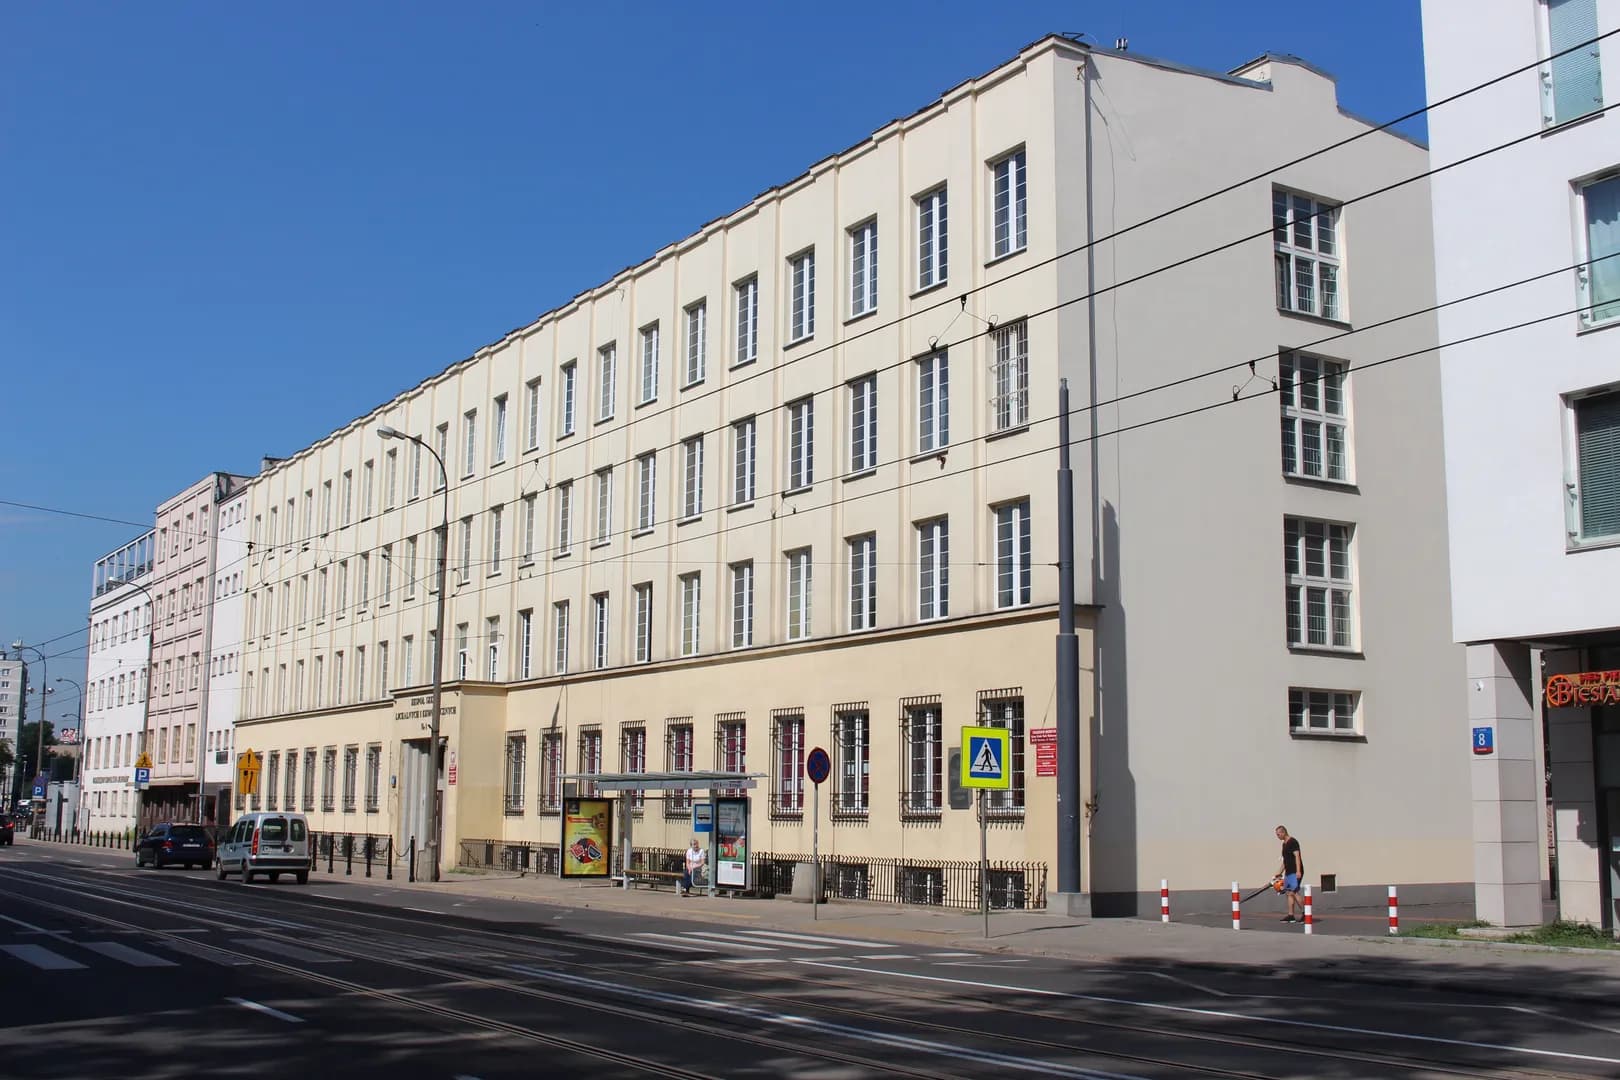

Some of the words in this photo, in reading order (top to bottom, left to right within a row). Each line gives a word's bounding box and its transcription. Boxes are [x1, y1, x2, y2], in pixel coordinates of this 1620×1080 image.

[1478, 733, 1486, 746] 8
[139, 769, 148, 780] P
[35, 786, 42, 794] P
